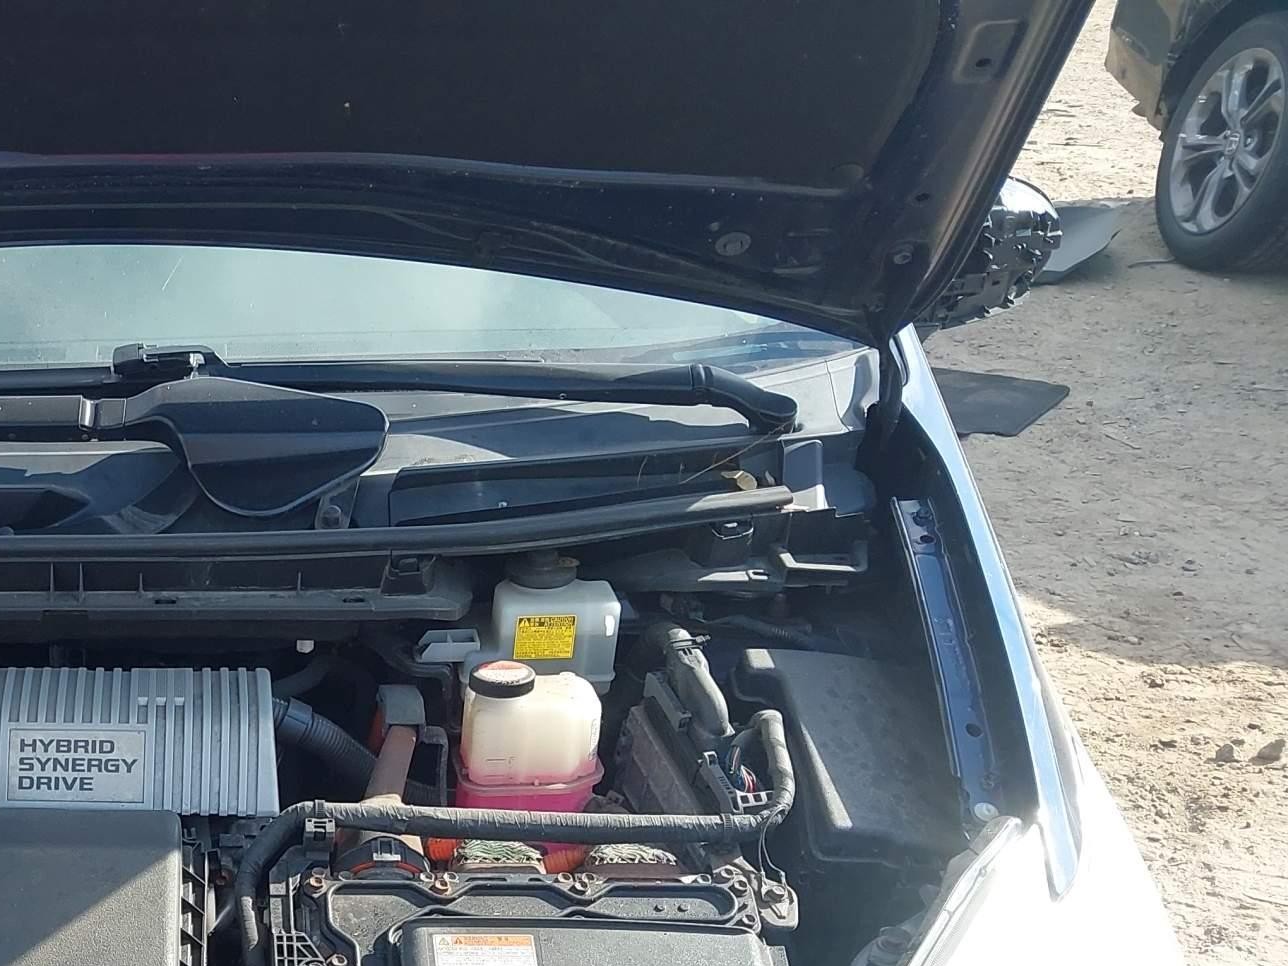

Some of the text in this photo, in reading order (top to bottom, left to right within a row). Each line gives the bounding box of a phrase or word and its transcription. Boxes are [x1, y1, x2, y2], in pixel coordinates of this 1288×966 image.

[19, 739, 115, 754] HYBRID
[18, 757, 138, 773] SYNERGY
[18, 776, 94, 791] DRIVE
